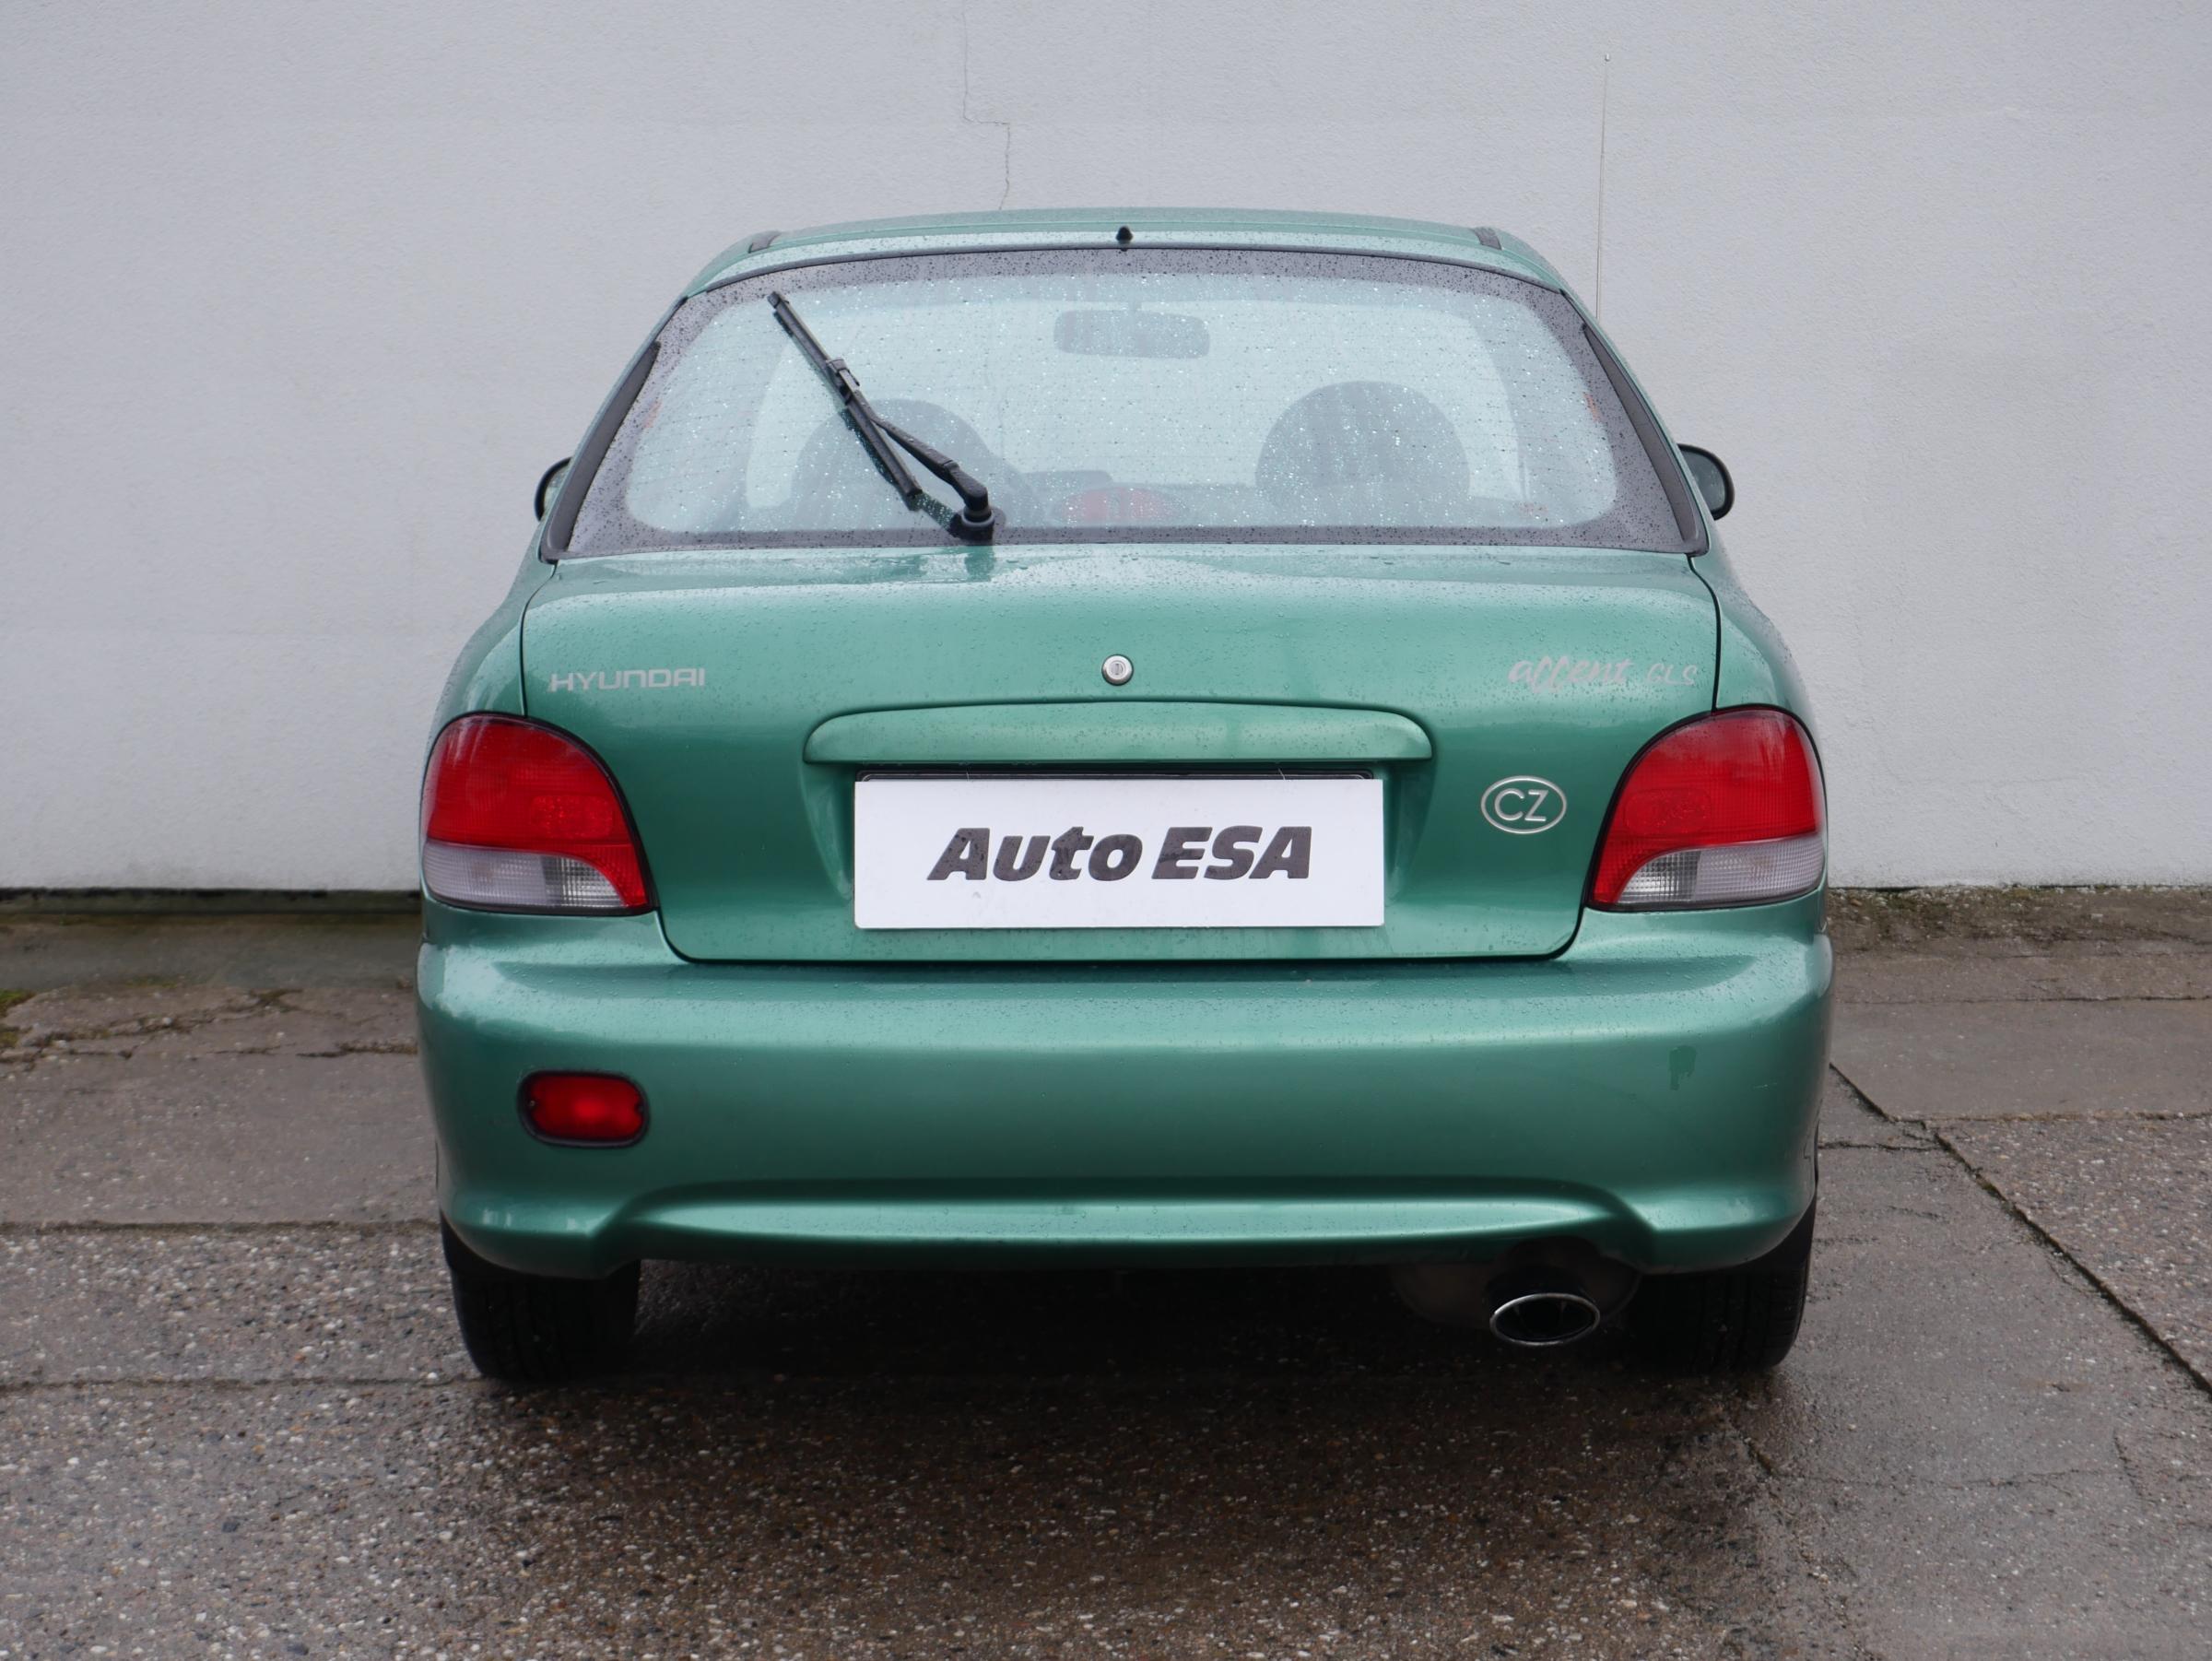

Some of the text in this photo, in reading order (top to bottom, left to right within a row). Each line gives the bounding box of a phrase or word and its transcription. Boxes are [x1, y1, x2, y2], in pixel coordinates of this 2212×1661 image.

[547, 668, 705, 692] HYUNDAI
[1494, 788, 1548, 821] CZ
[926, 825, 1312, 881] Auto ESA
